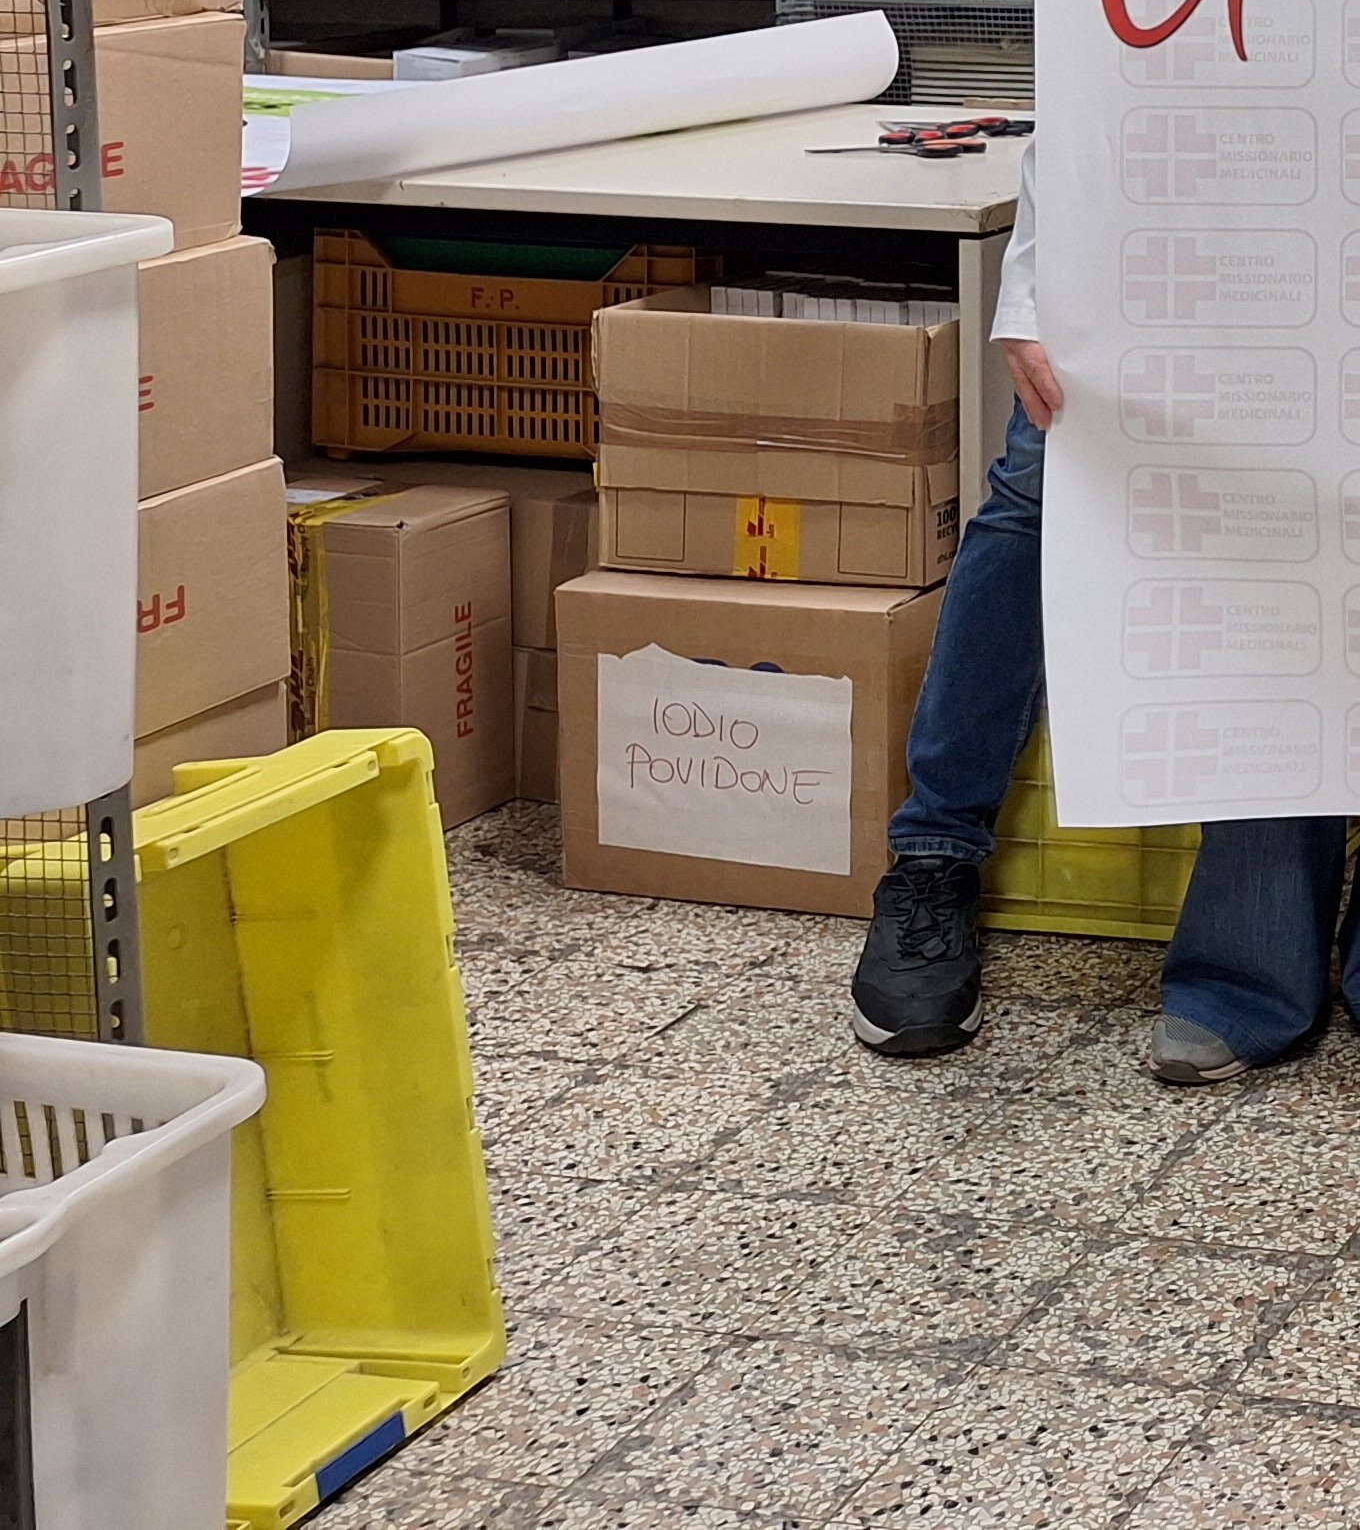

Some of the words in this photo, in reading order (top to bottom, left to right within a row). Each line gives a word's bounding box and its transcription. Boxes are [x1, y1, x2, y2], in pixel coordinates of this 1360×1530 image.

[1219, 132, 1275, 147] CENTRO
[1219, 148, 1314, 164] MISSIONARIO
[1219, 166, 1303, 181] MEDICINALI
[455, 601, 475, 738] FRAGILE
[650, 696, 760, 752] IODIO
[625, 741, 833, 806] POVIDONE
